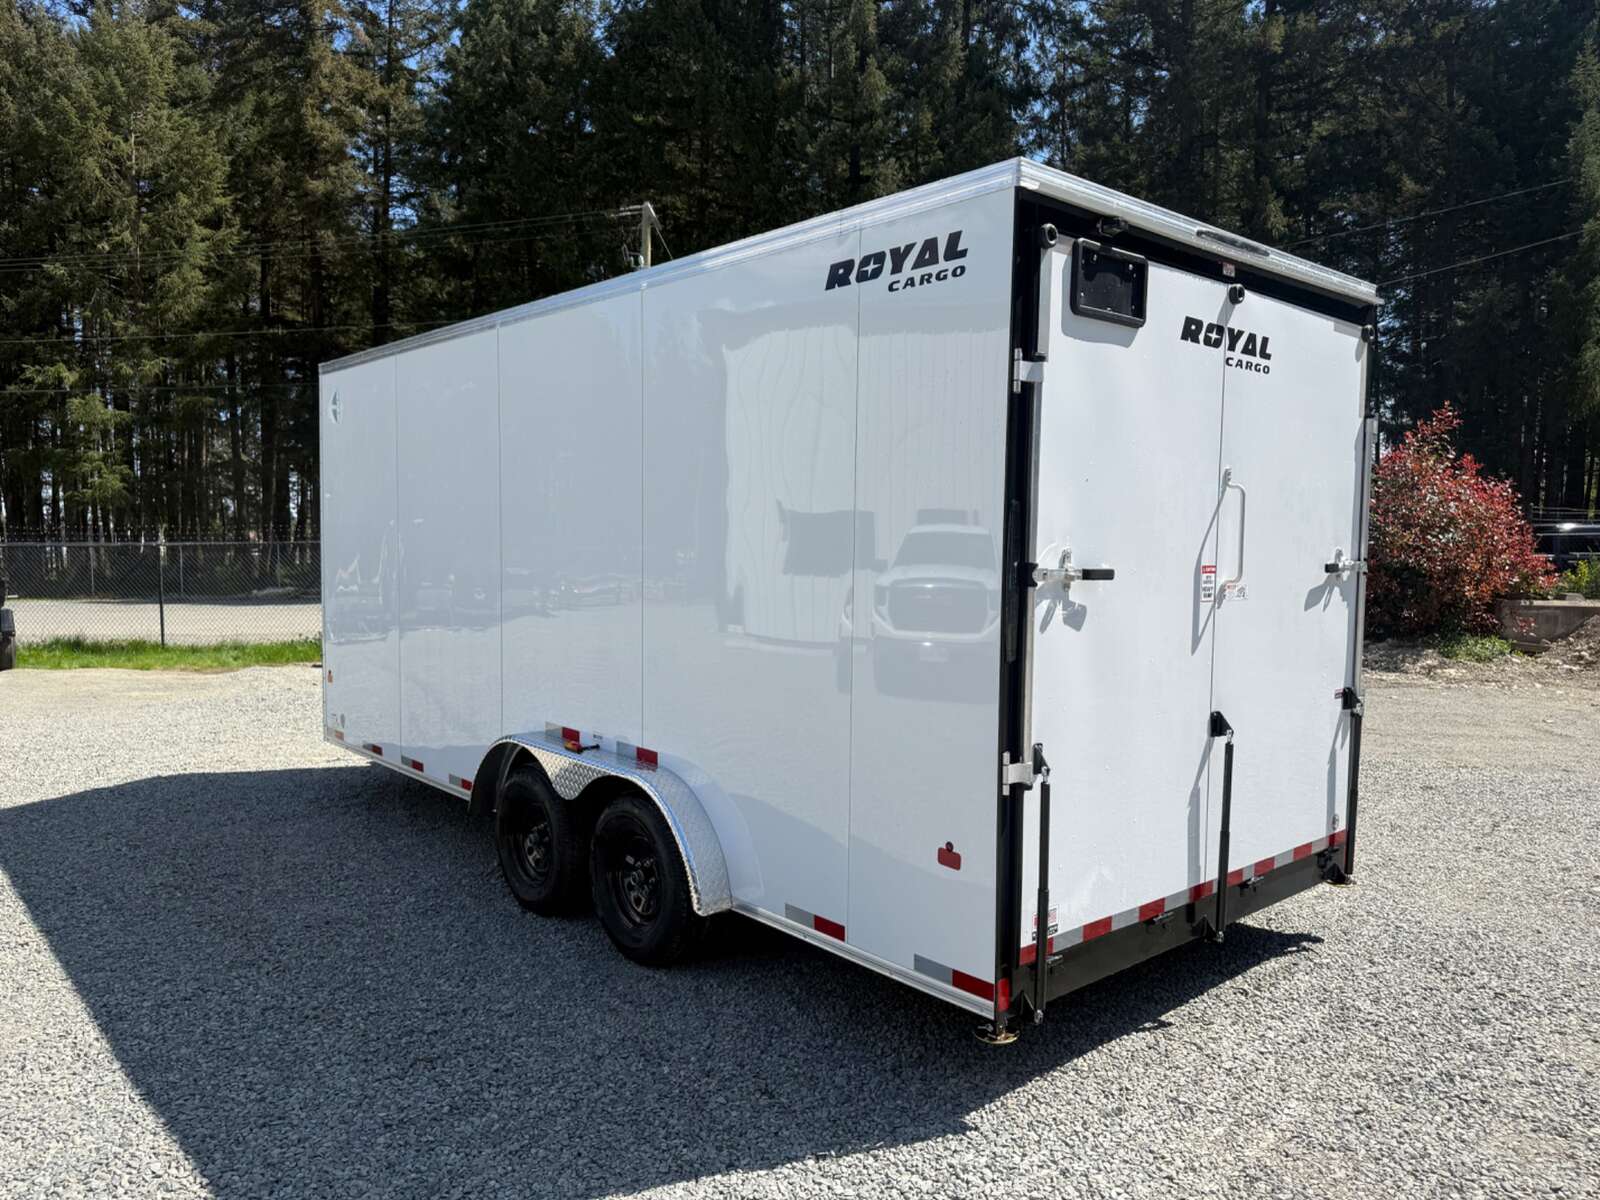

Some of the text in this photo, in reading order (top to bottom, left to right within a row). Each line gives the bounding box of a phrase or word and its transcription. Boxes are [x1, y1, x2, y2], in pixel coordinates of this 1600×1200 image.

[825, 230, 968, 291] ROYAL
[888, 265, 966, 292] CARGO
[1180, 315, 1272, 361] ROYAL
[1225, 357, 1270, 374] CARGO
